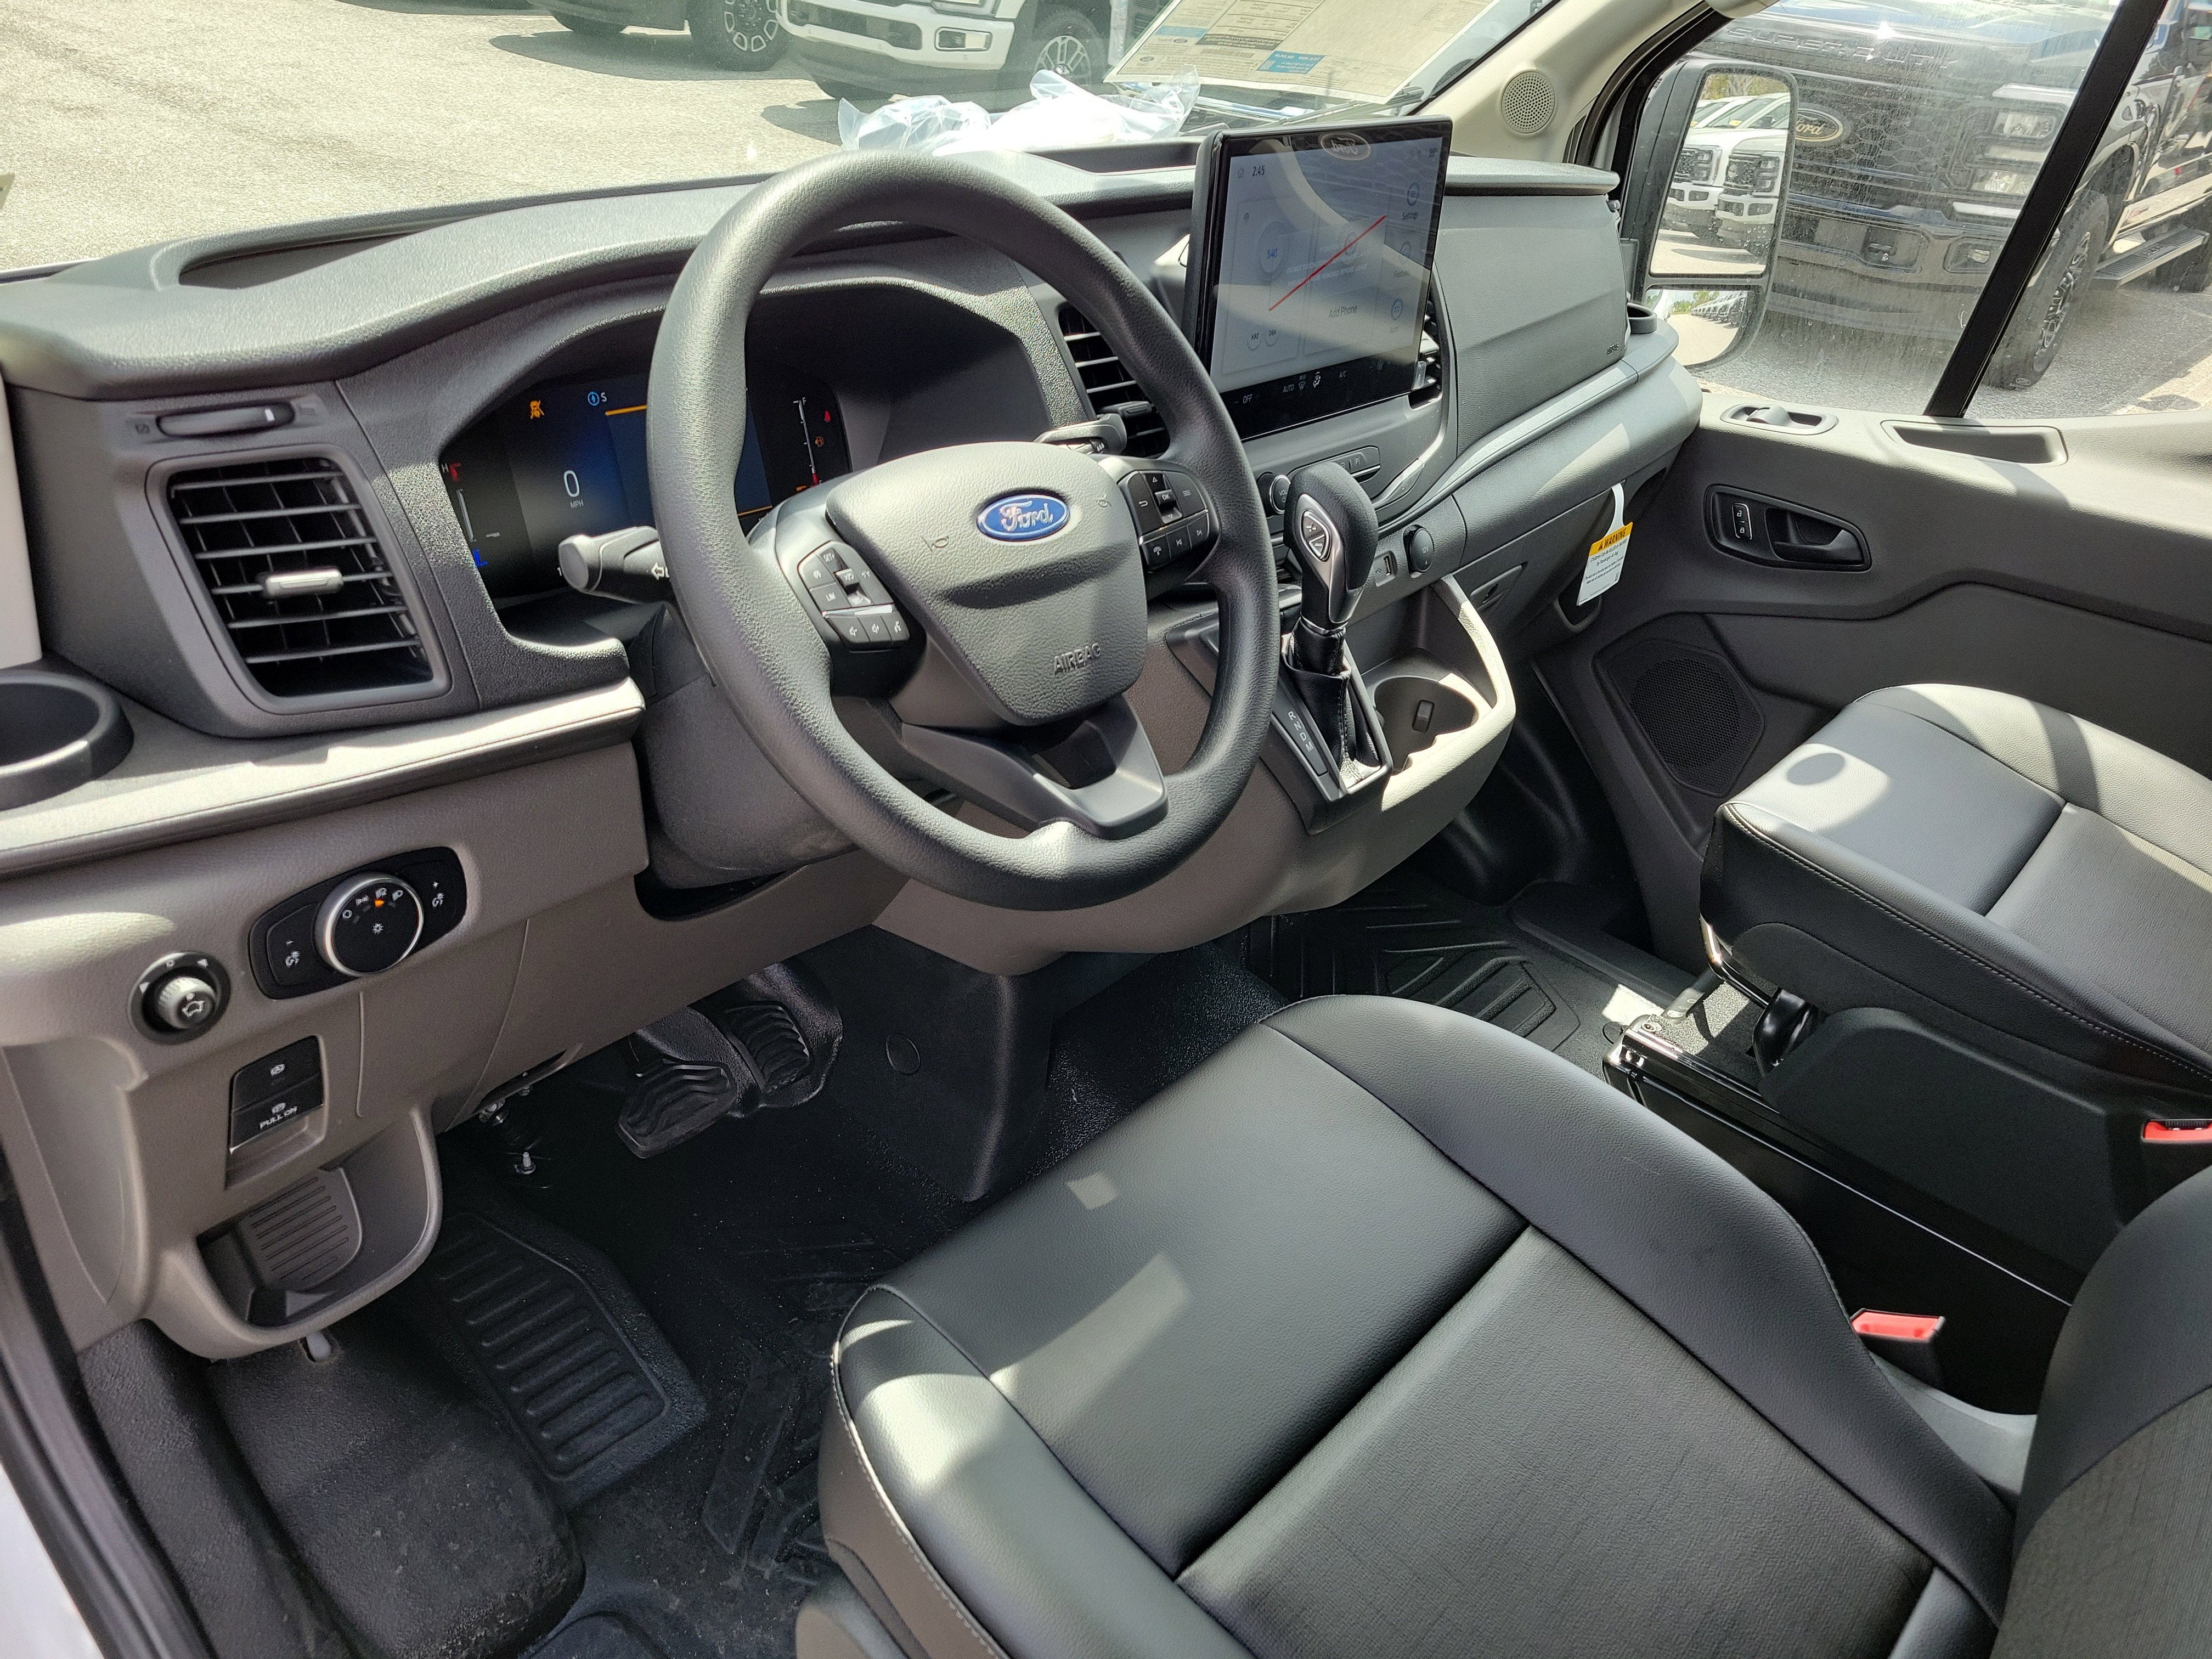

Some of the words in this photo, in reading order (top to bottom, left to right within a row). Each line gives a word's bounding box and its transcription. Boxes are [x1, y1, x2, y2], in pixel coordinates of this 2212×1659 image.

[1728, 27, 1847, 55] SUPER
[601, 392, 607, 402] S
[1243, 394, 1253, 404] OFF
[1283, 384, 1294, 393] AUTO
[563, 470, 580, 498] 0
[570, 499, 584, 509] MPH
[999, 500, 1054, 532] Ford
[1604, 528, 1627, 549] WARNING
[1054, 642, 1101, 675] AIRBAG
[1288, 711, 1296, 721] R
[1294, 721, 1302, 731] N
[1299, 732, 1307, 741] D
[1305, 741, 1314, 752] M
[259, 1114, 284, 1130] PULL
[284, 1105, 298, 1117] ON
